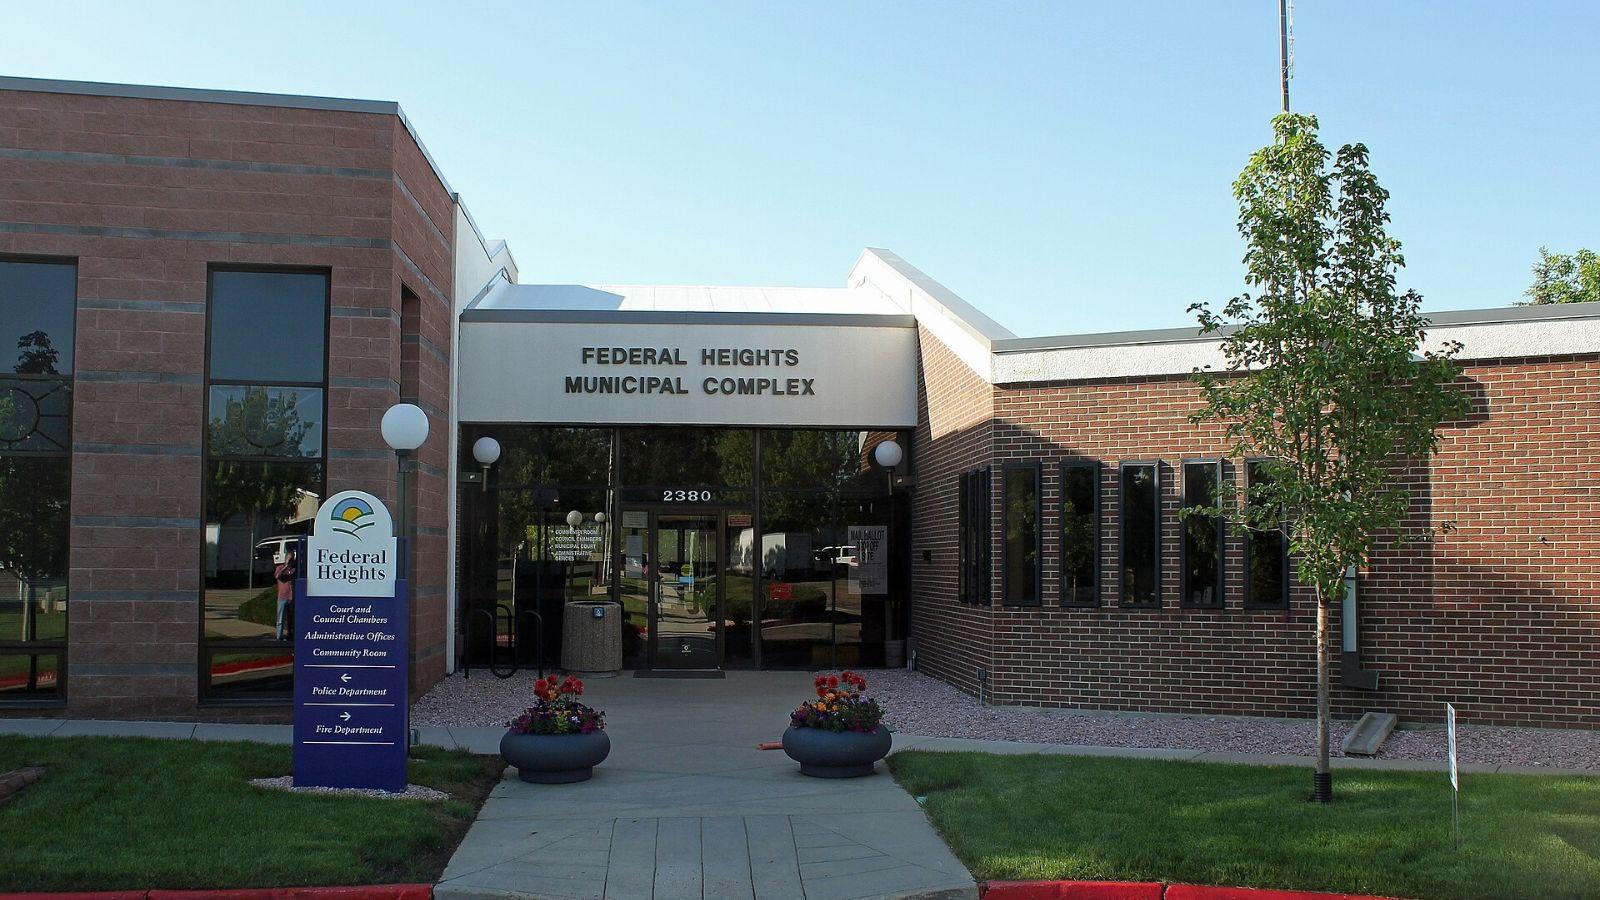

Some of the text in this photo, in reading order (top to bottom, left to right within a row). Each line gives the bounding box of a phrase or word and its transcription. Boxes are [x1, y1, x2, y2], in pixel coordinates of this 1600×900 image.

[582, 347, 800, 367] FEDERAL HEIGHTS
[565, 376, 815, 396] MUNICIPAL COMPLEX
[663, 490, 711, 502] 2380
[316, 549, 387, 564] Federal
[316, 564, 386, 584] Heights
[329, 604, 372, 614] Court and
[313, 614, 388, 624] Council Chambers
[304, 631, 395, 642] Administrative Offices
[313, 648, 387, 659] Community Room
[312, 686, 387, 697] Police Department
[315, 724, 383, 735] Fire Department
